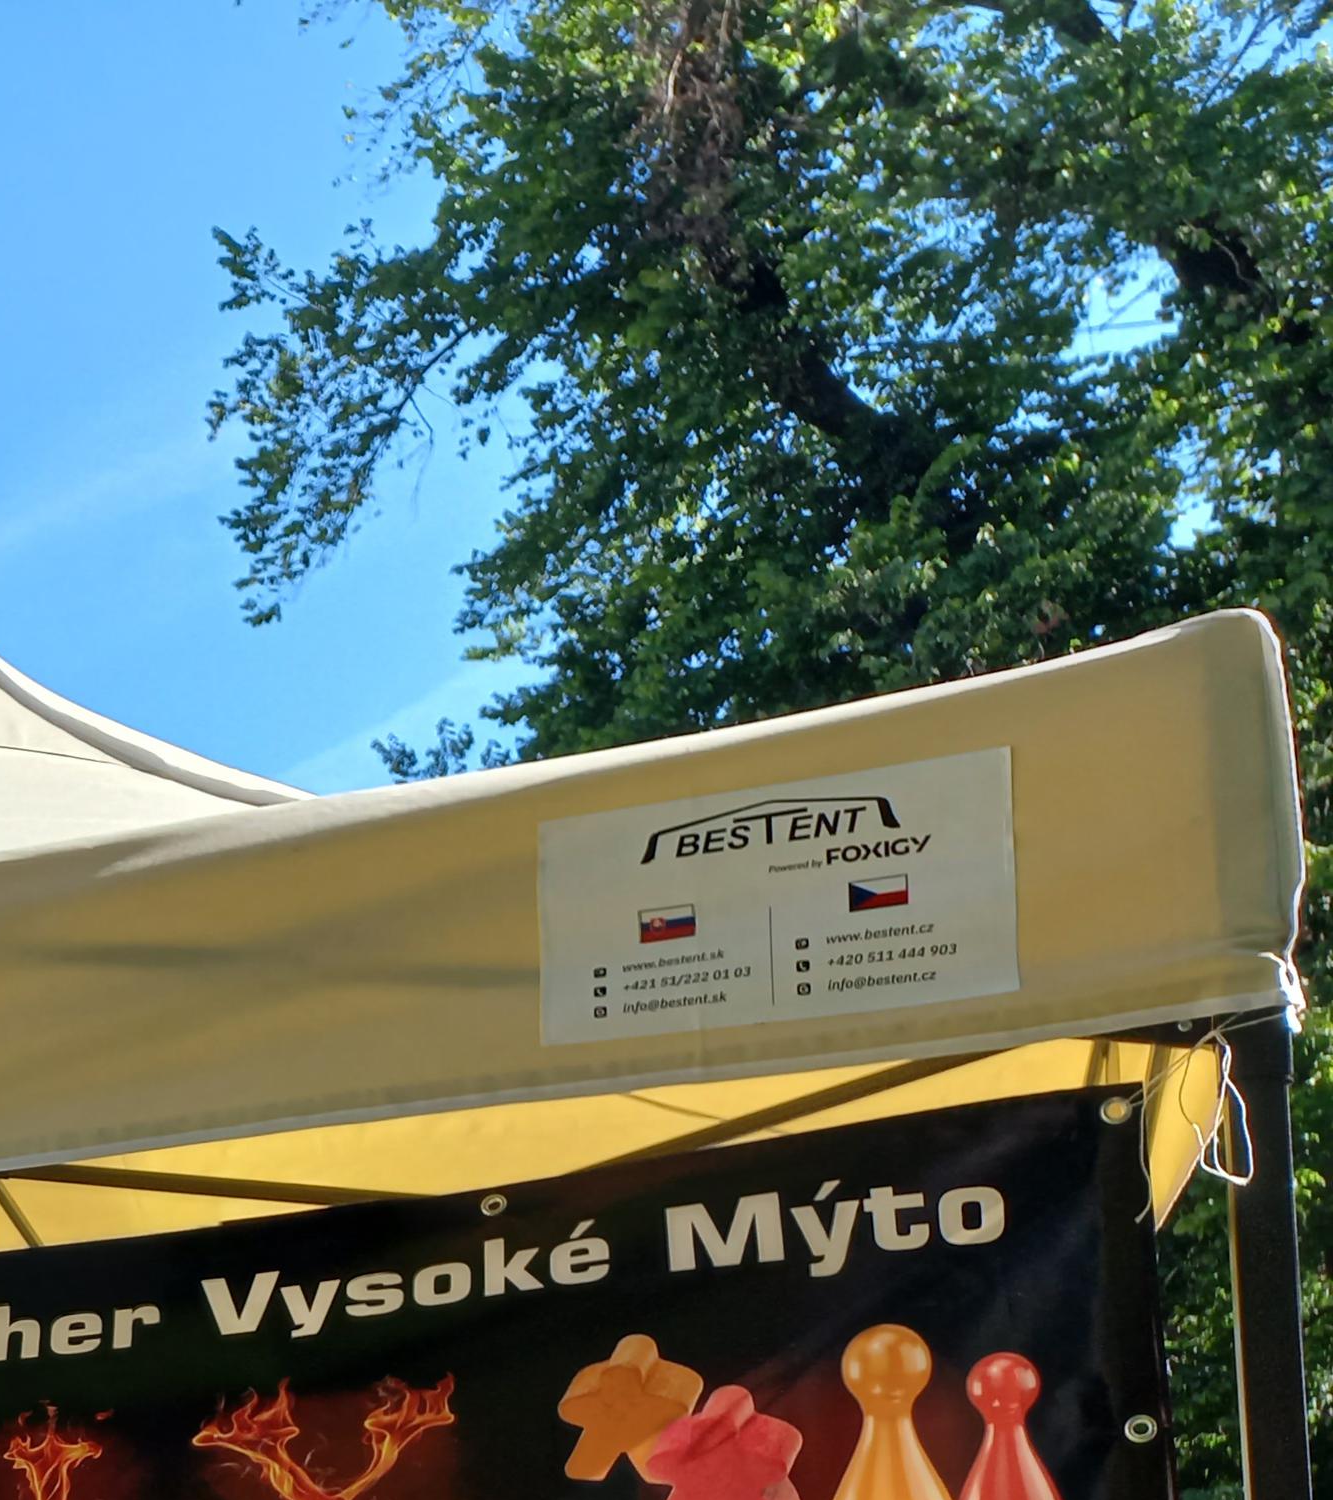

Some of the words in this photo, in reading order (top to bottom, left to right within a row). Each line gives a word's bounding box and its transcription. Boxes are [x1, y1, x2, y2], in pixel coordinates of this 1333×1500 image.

[675, 806, 867, 858] BESTENT
[768, 859, 809, 873] Powered
[810, 858, 823, 870] by
[826, 834, 932, 866] FOXIGY
[825, 922, 935, 945] www.bestent.cz
[621, 948, 725, 973] www.bestent.sk
[827, 953, 863, 967] +420
[867, 950, 895, 963] 511
[898, 947, 926, 959] 444
[930, 943, 958, 956] 903
[623, 978, 656, 992] +421
[713, 968, 730, 981] 01
[734, 966, 752, 978] 03
[827, 970, 937, 992] info@bestent.cz
[622, 991, 728, 1015] info@bestent.sk
[200, 1218, 611, 1338] Vysoké
[664, 1179, 1006, 1278] Mýto
